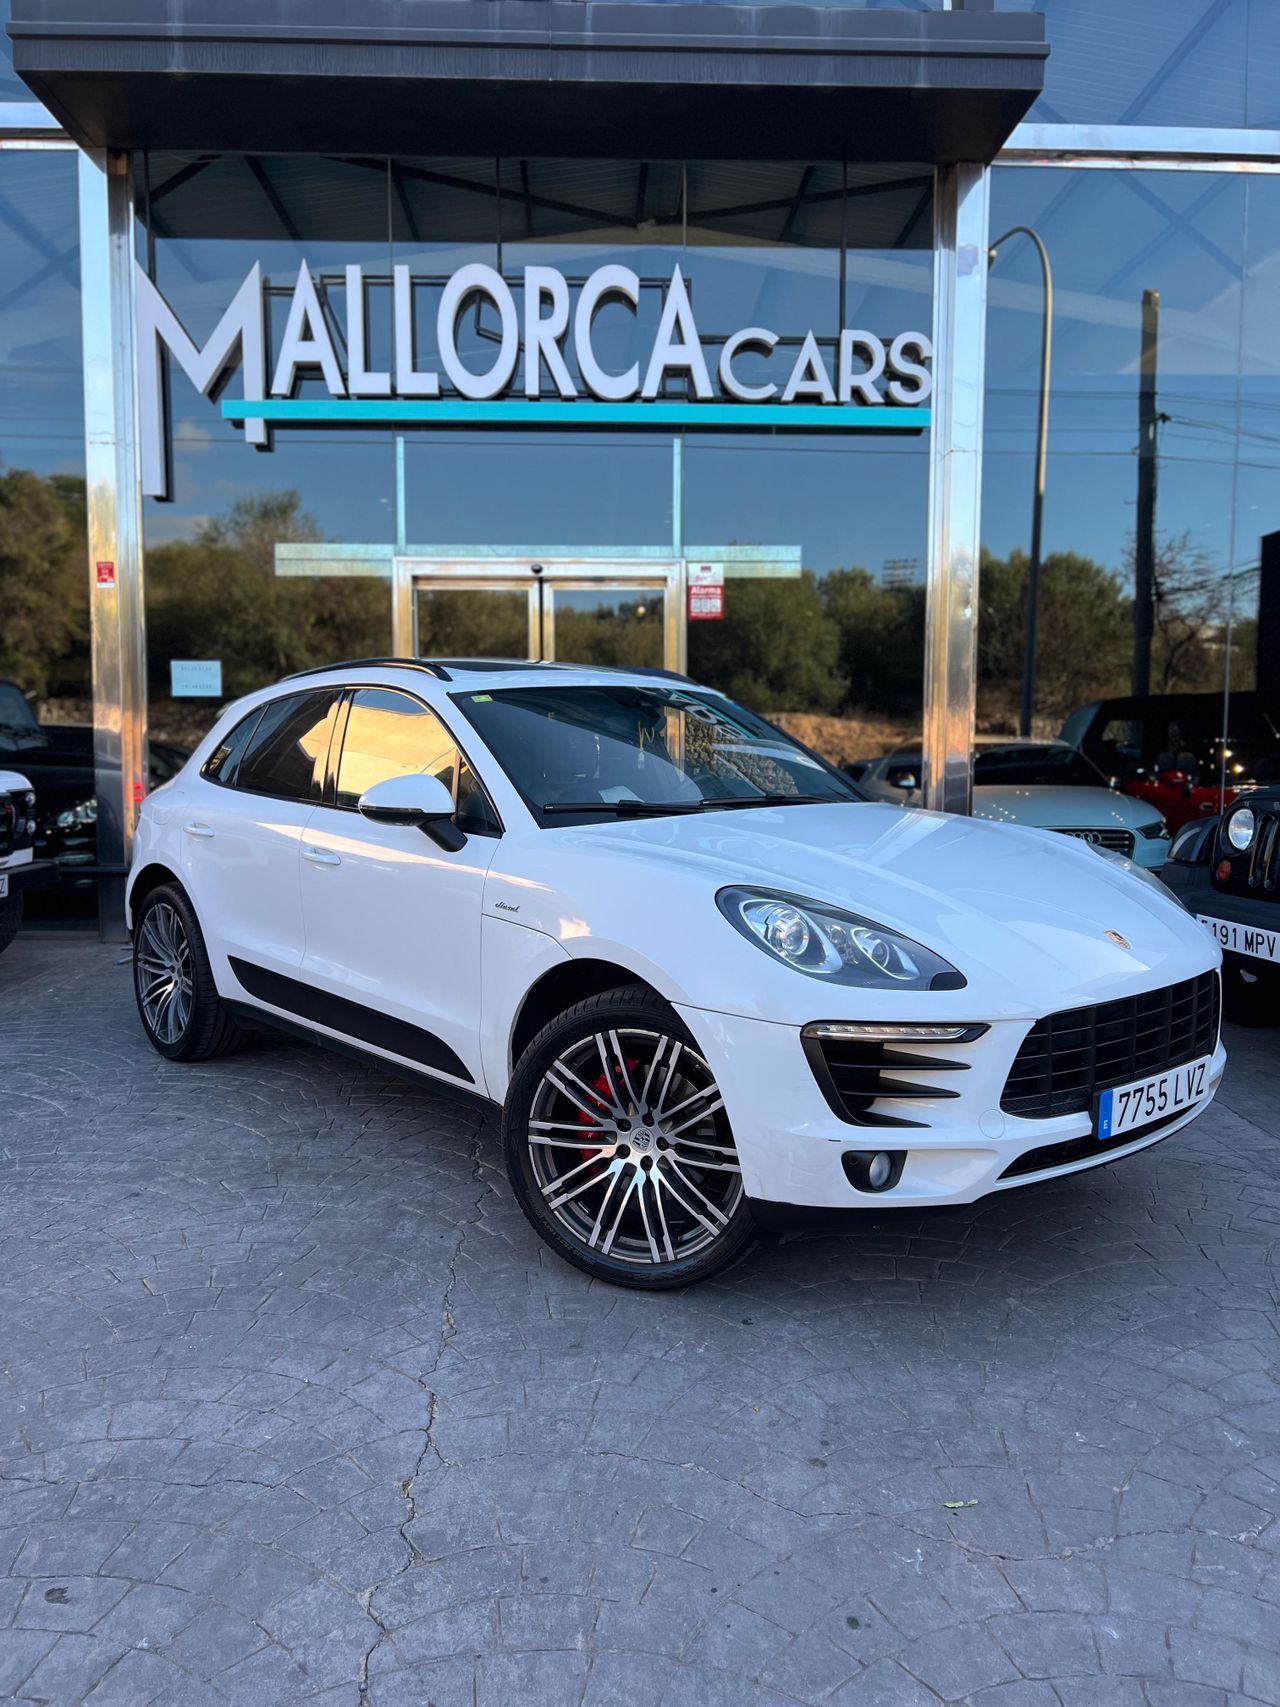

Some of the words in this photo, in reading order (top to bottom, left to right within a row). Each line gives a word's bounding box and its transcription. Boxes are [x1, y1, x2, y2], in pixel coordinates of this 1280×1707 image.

[135, 258, 713, 498] MALLORCA
[719, 327, 933, 405] CARS
[691, 586, 721, 595] Alarma
[1201, 919, 1237, 948] 191
[1244, 930, 1276, 958] MPV
[1118, 1079, 1168, 1127] 7755
[1174, 1063, 1206, 1106] LVZ
[1103, 1119, 1109, 1130] E
